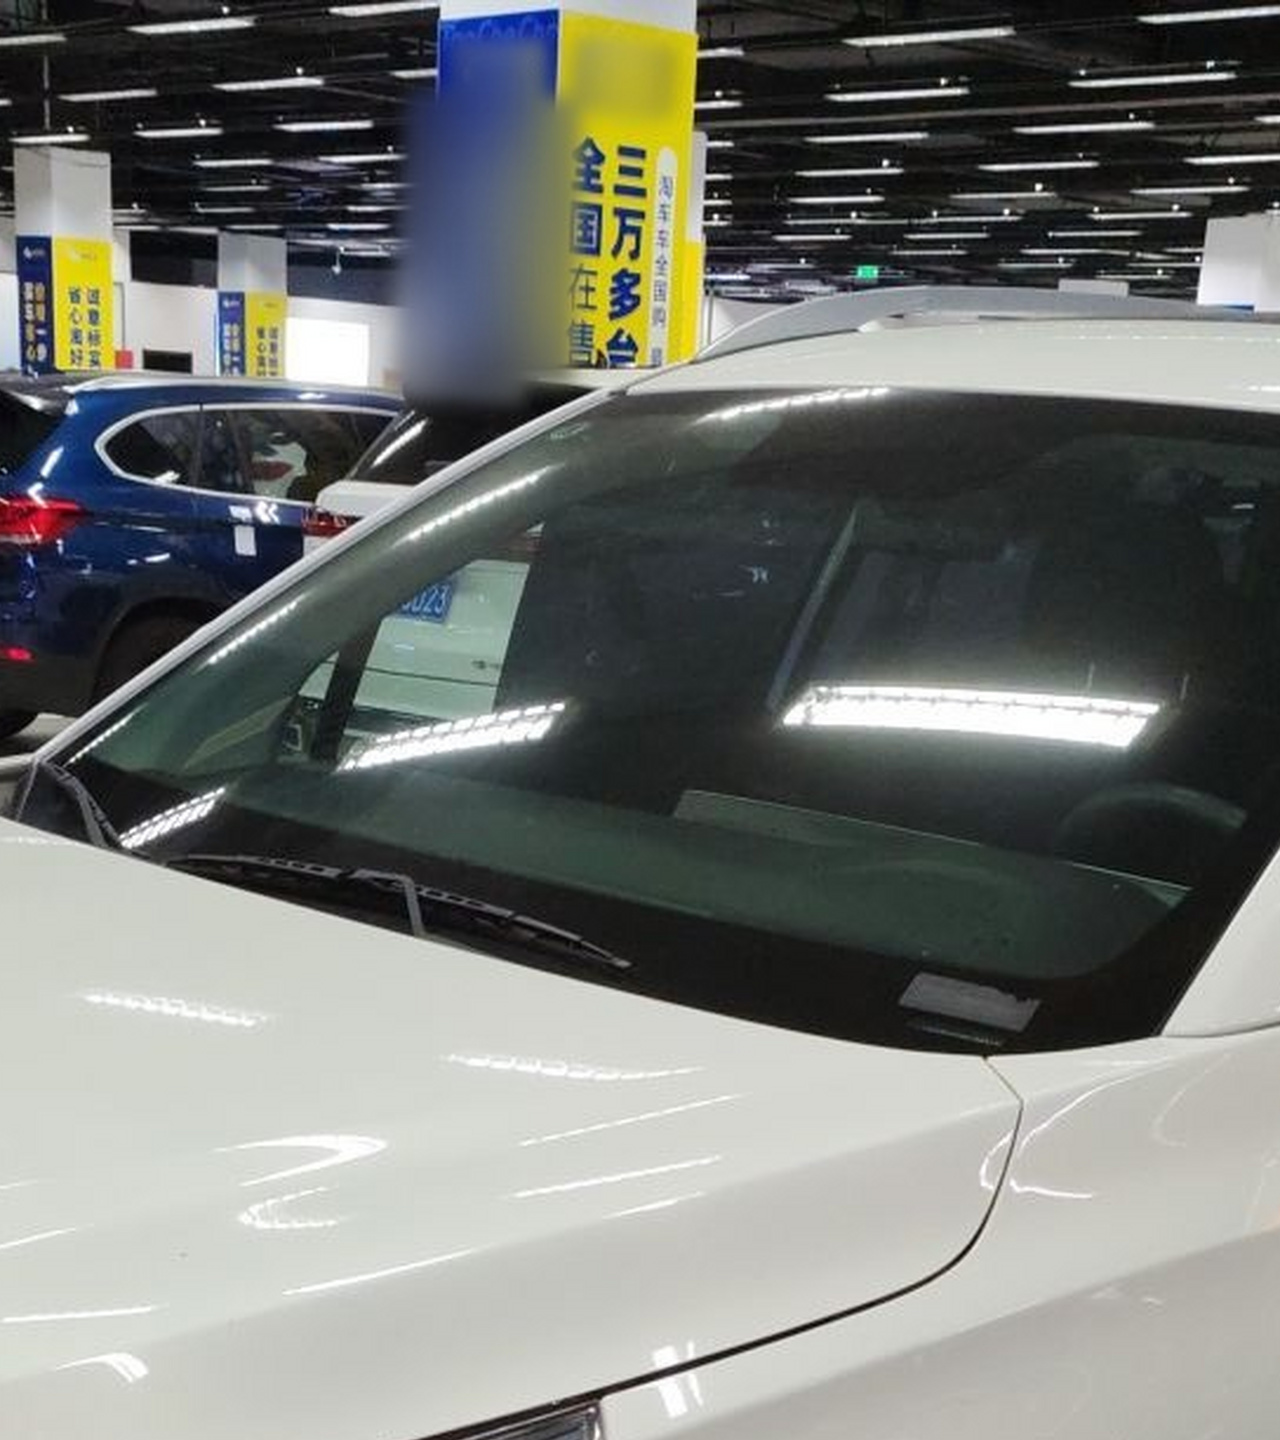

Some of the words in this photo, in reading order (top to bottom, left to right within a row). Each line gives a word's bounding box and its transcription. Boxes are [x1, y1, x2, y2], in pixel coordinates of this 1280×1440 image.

[567, 136, 606, 368] 全国在售
[606, 145, 648, 368] 三万多台
